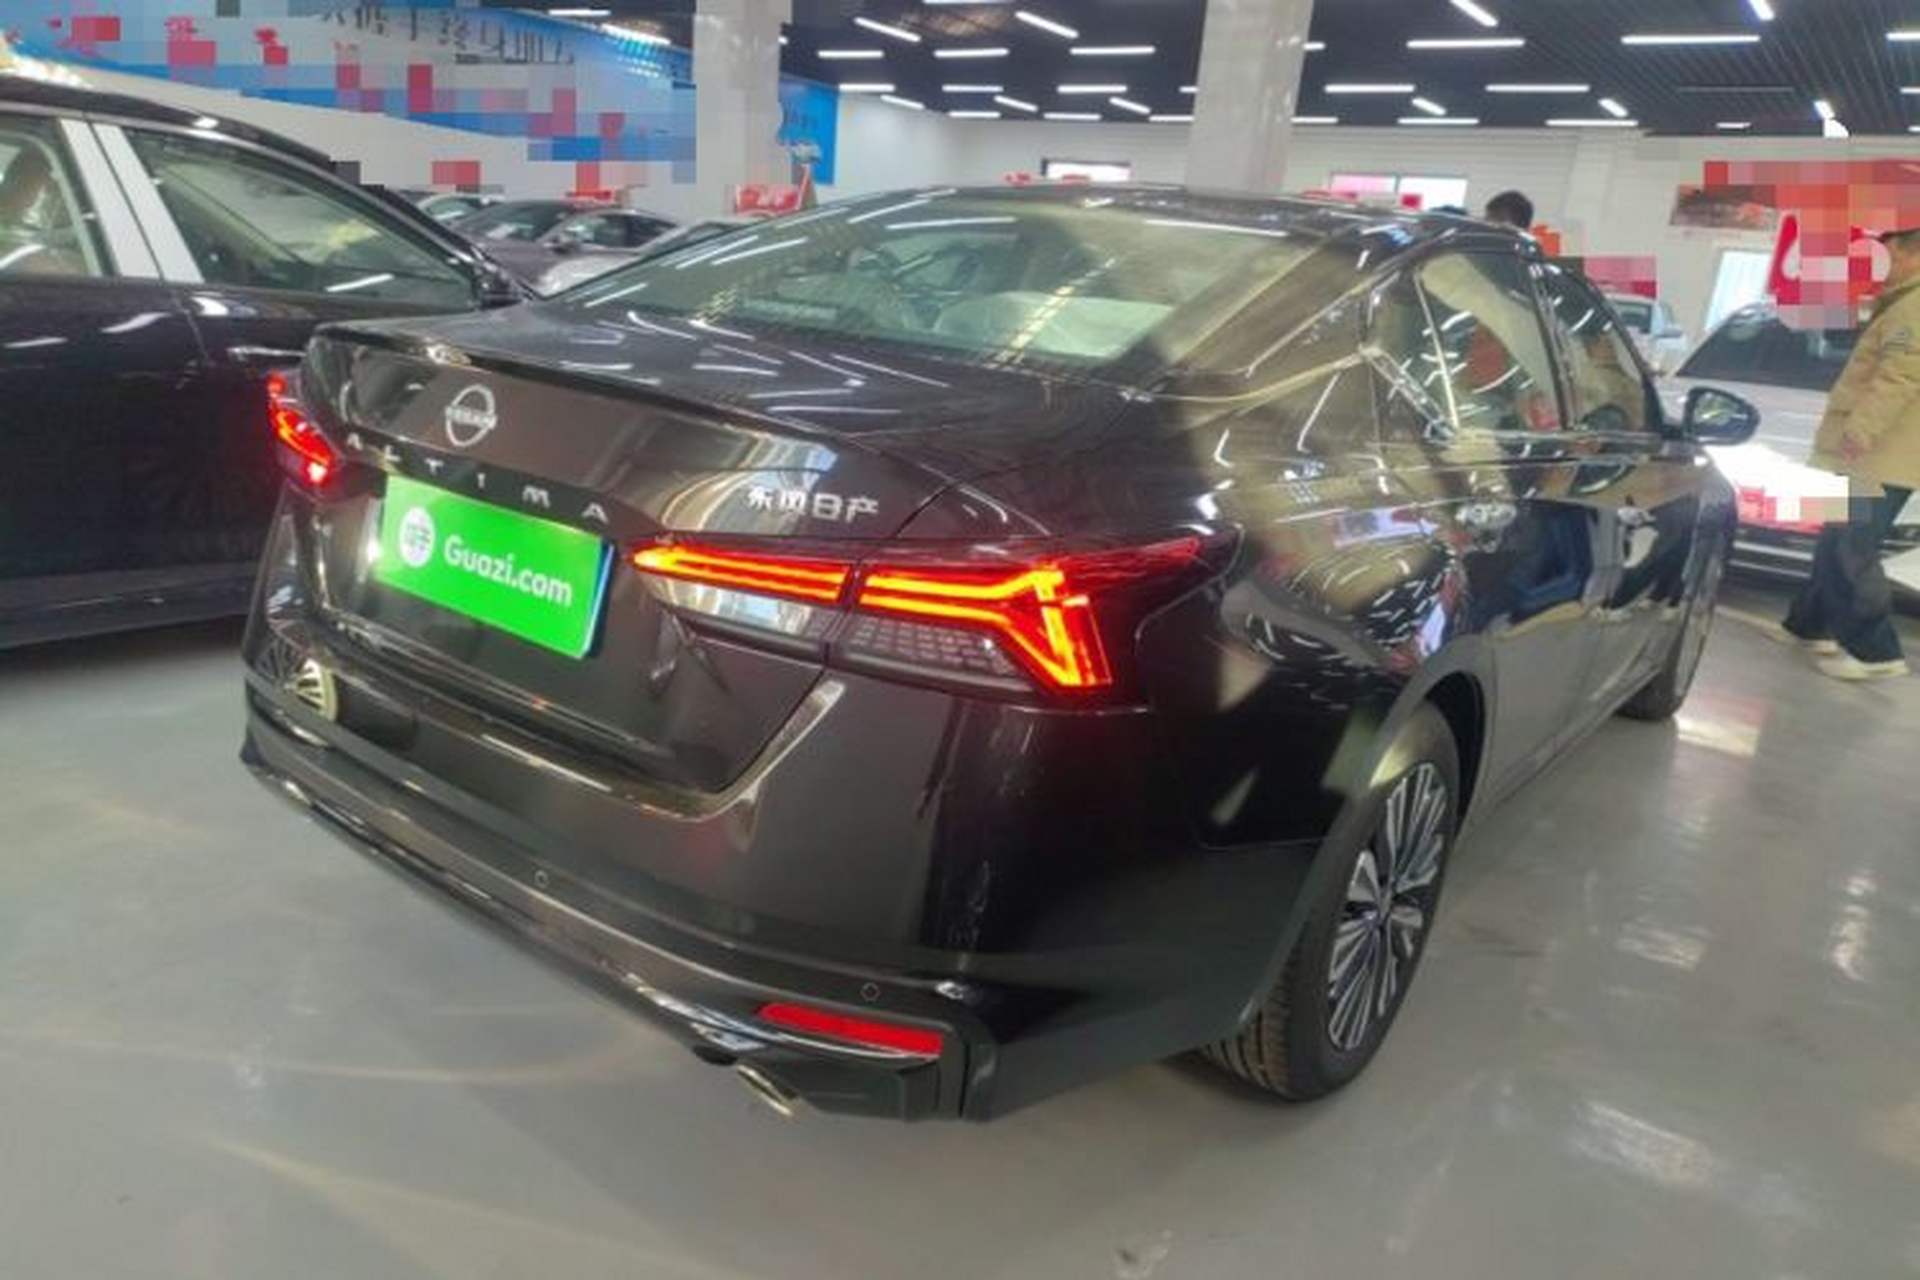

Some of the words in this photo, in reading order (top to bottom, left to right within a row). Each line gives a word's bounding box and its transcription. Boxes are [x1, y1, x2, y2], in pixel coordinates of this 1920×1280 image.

[348, 433, 608, 523] ALTIMA
[748, 486, 879, 522] 东风日产
